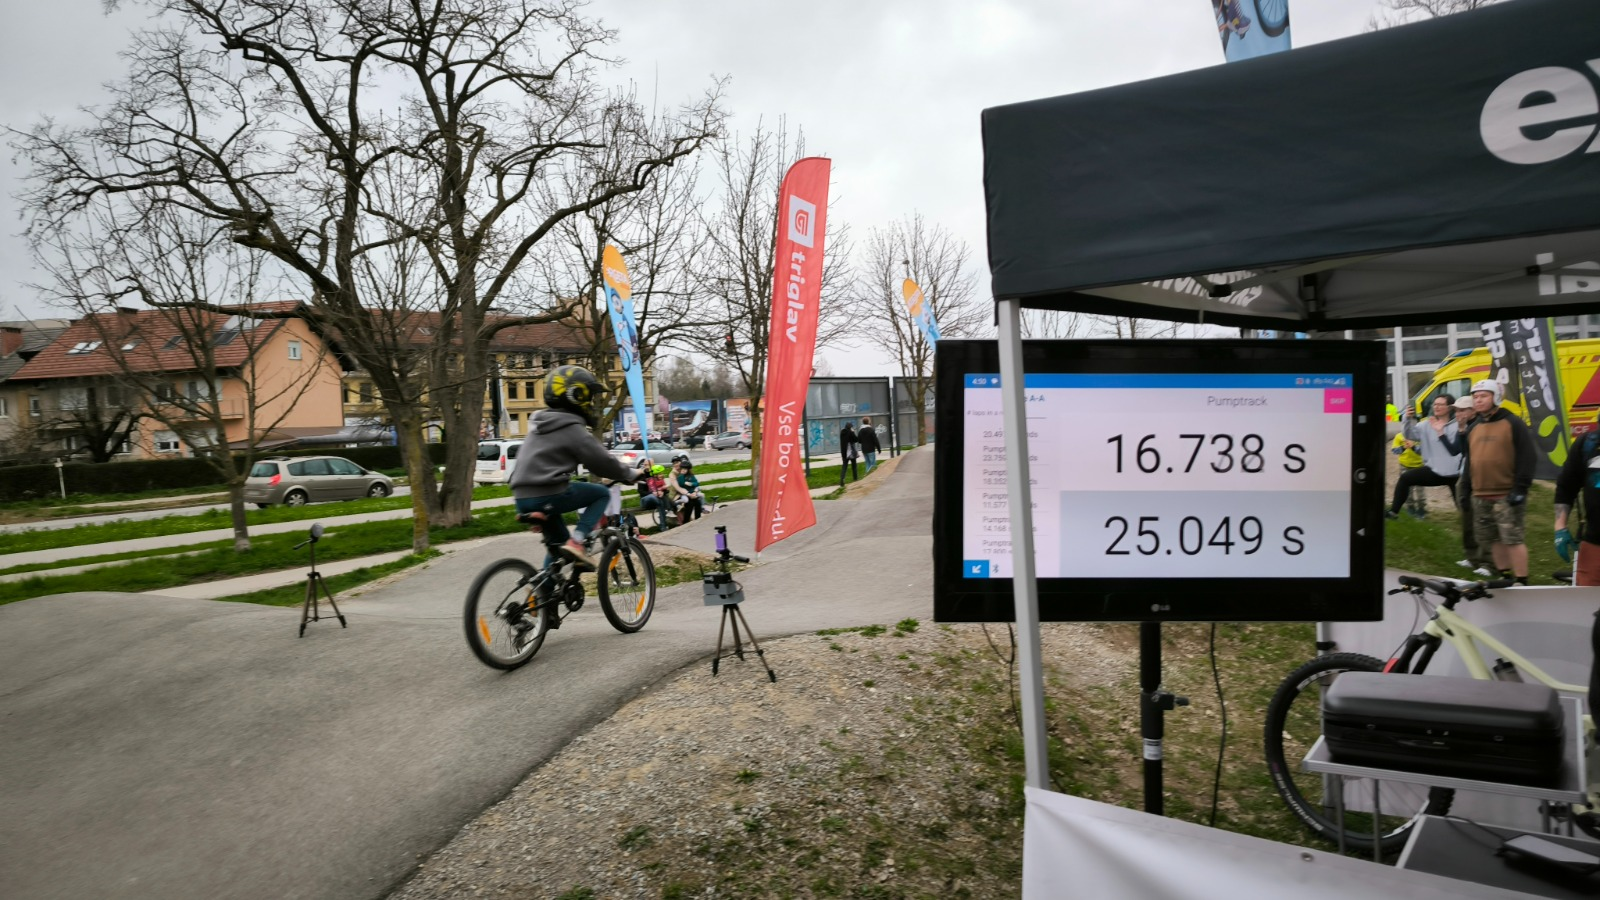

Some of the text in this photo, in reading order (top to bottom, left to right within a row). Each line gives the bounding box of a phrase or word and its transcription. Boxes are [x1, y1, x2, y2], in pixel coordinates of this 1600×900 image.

[786, 251, 806, 343] triglav
[778, 401, 796, 436] Vse
[1207, 395, 1268, 408] Pumptrack
[778, 443, 794, 468] bo
[1107, 433, 1306, 474] 16.738 s
[1104, 516, 1305, 556] 25.049 s
